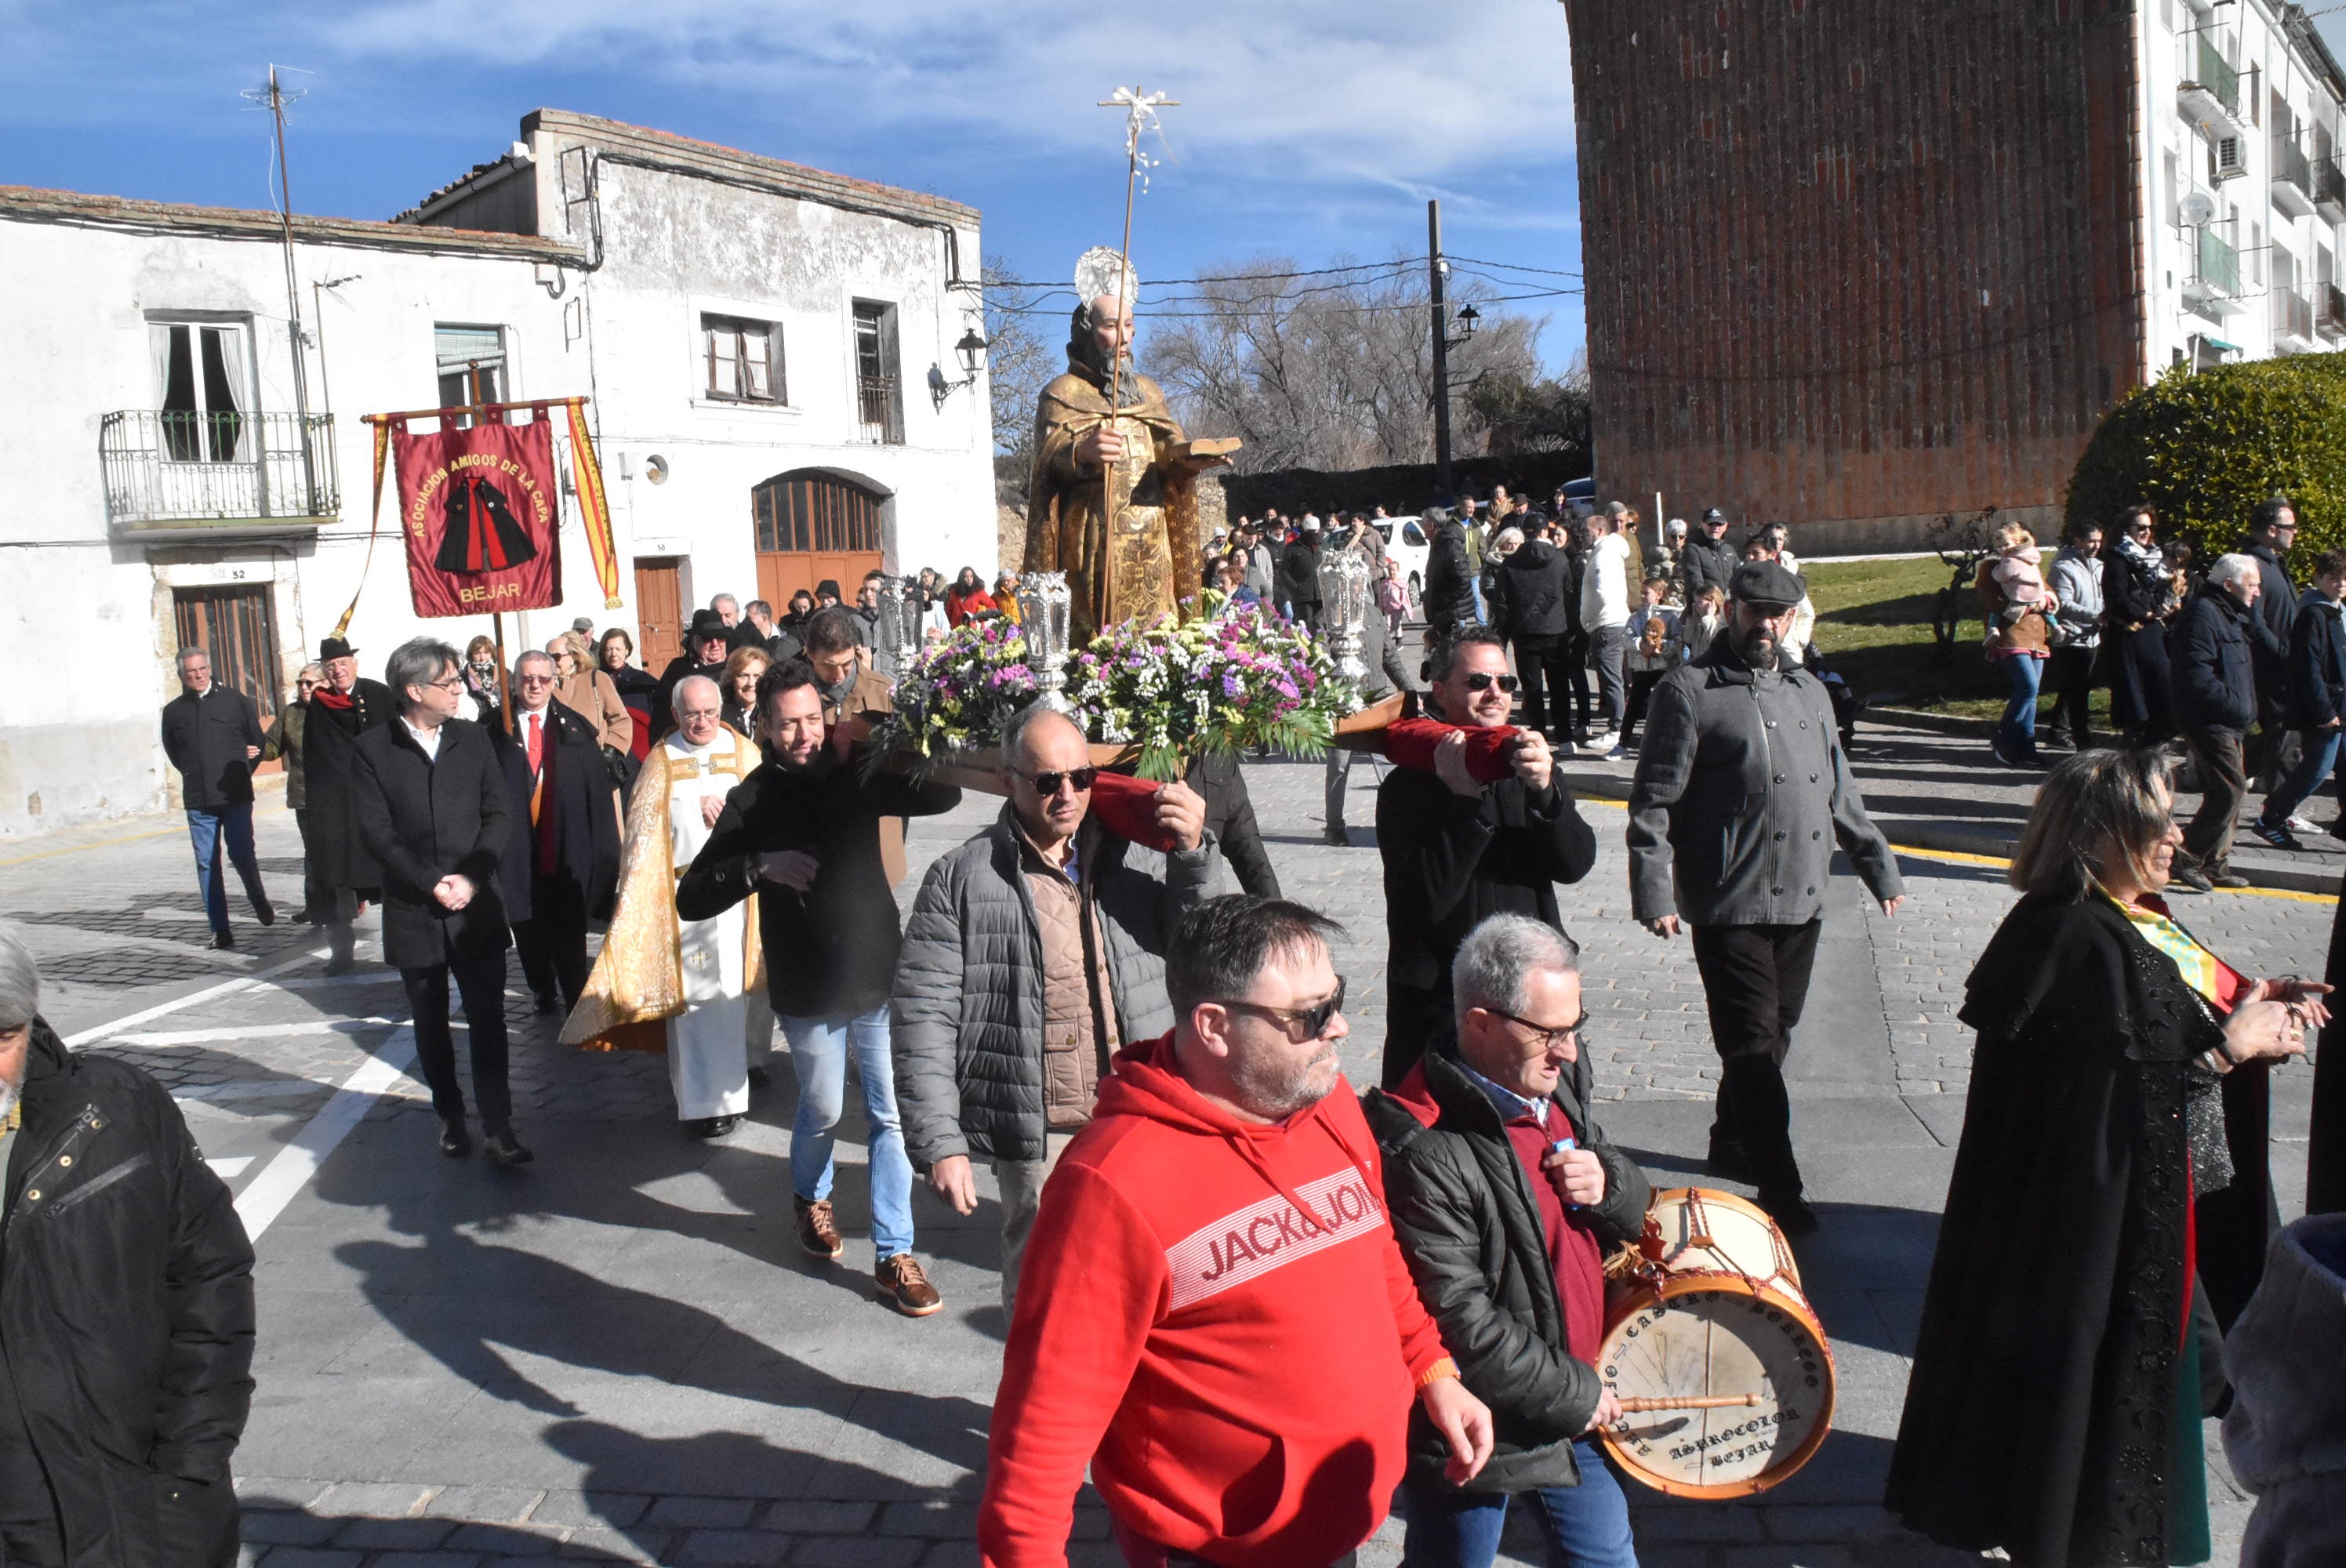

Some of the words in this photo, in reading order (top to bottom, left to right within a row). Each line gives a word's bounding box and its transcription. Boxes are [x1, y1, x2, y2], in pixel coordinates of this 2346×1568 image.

[412, 467, 448, 538] ASOCIACION
[450, 453, 498, 472] AMIGOS
[500, 459, 519, 476] DE
[518, 472, 536, 491] LA
[532, 490, 549, 524] CAPA
[232, 569, 245, 579] 52
[459, 583, 521, 603] BEJAR
[1200, 1181, 1382, 1281] JACK&JON
[1625, 1290, 1720, 1338] CASTRO
[1603, 1364, 1652, 1457] ANTIO
[1669, 1408, 1800, 1460] ASPROCOLOR
[1710, 1439, 1775, 1469] BEJAR
